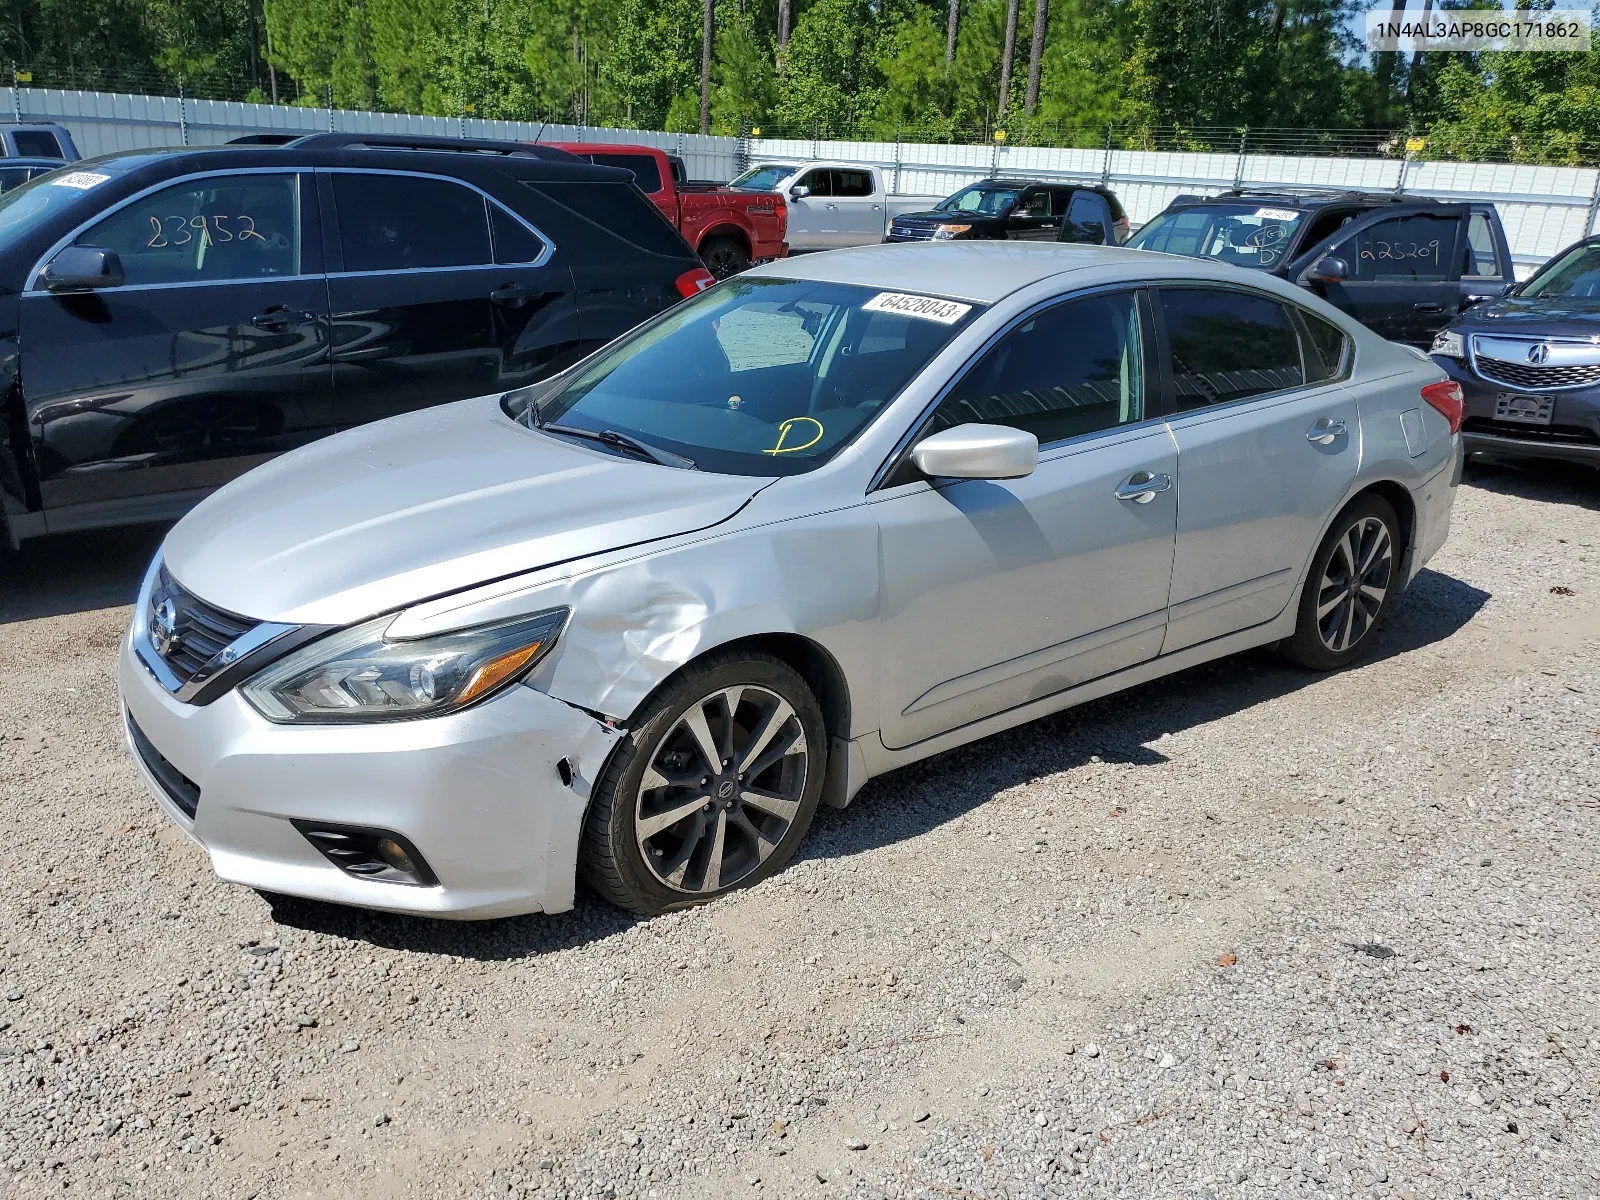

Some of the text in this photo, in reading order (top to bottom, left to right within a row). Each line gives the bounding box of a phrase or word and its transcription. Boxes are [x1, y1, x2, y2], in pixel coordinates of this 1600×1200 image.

[1360, 239, 1439, 267] 225209
[879, 295, 957, 318] 64528043
[761, 416, 824, 457] D
